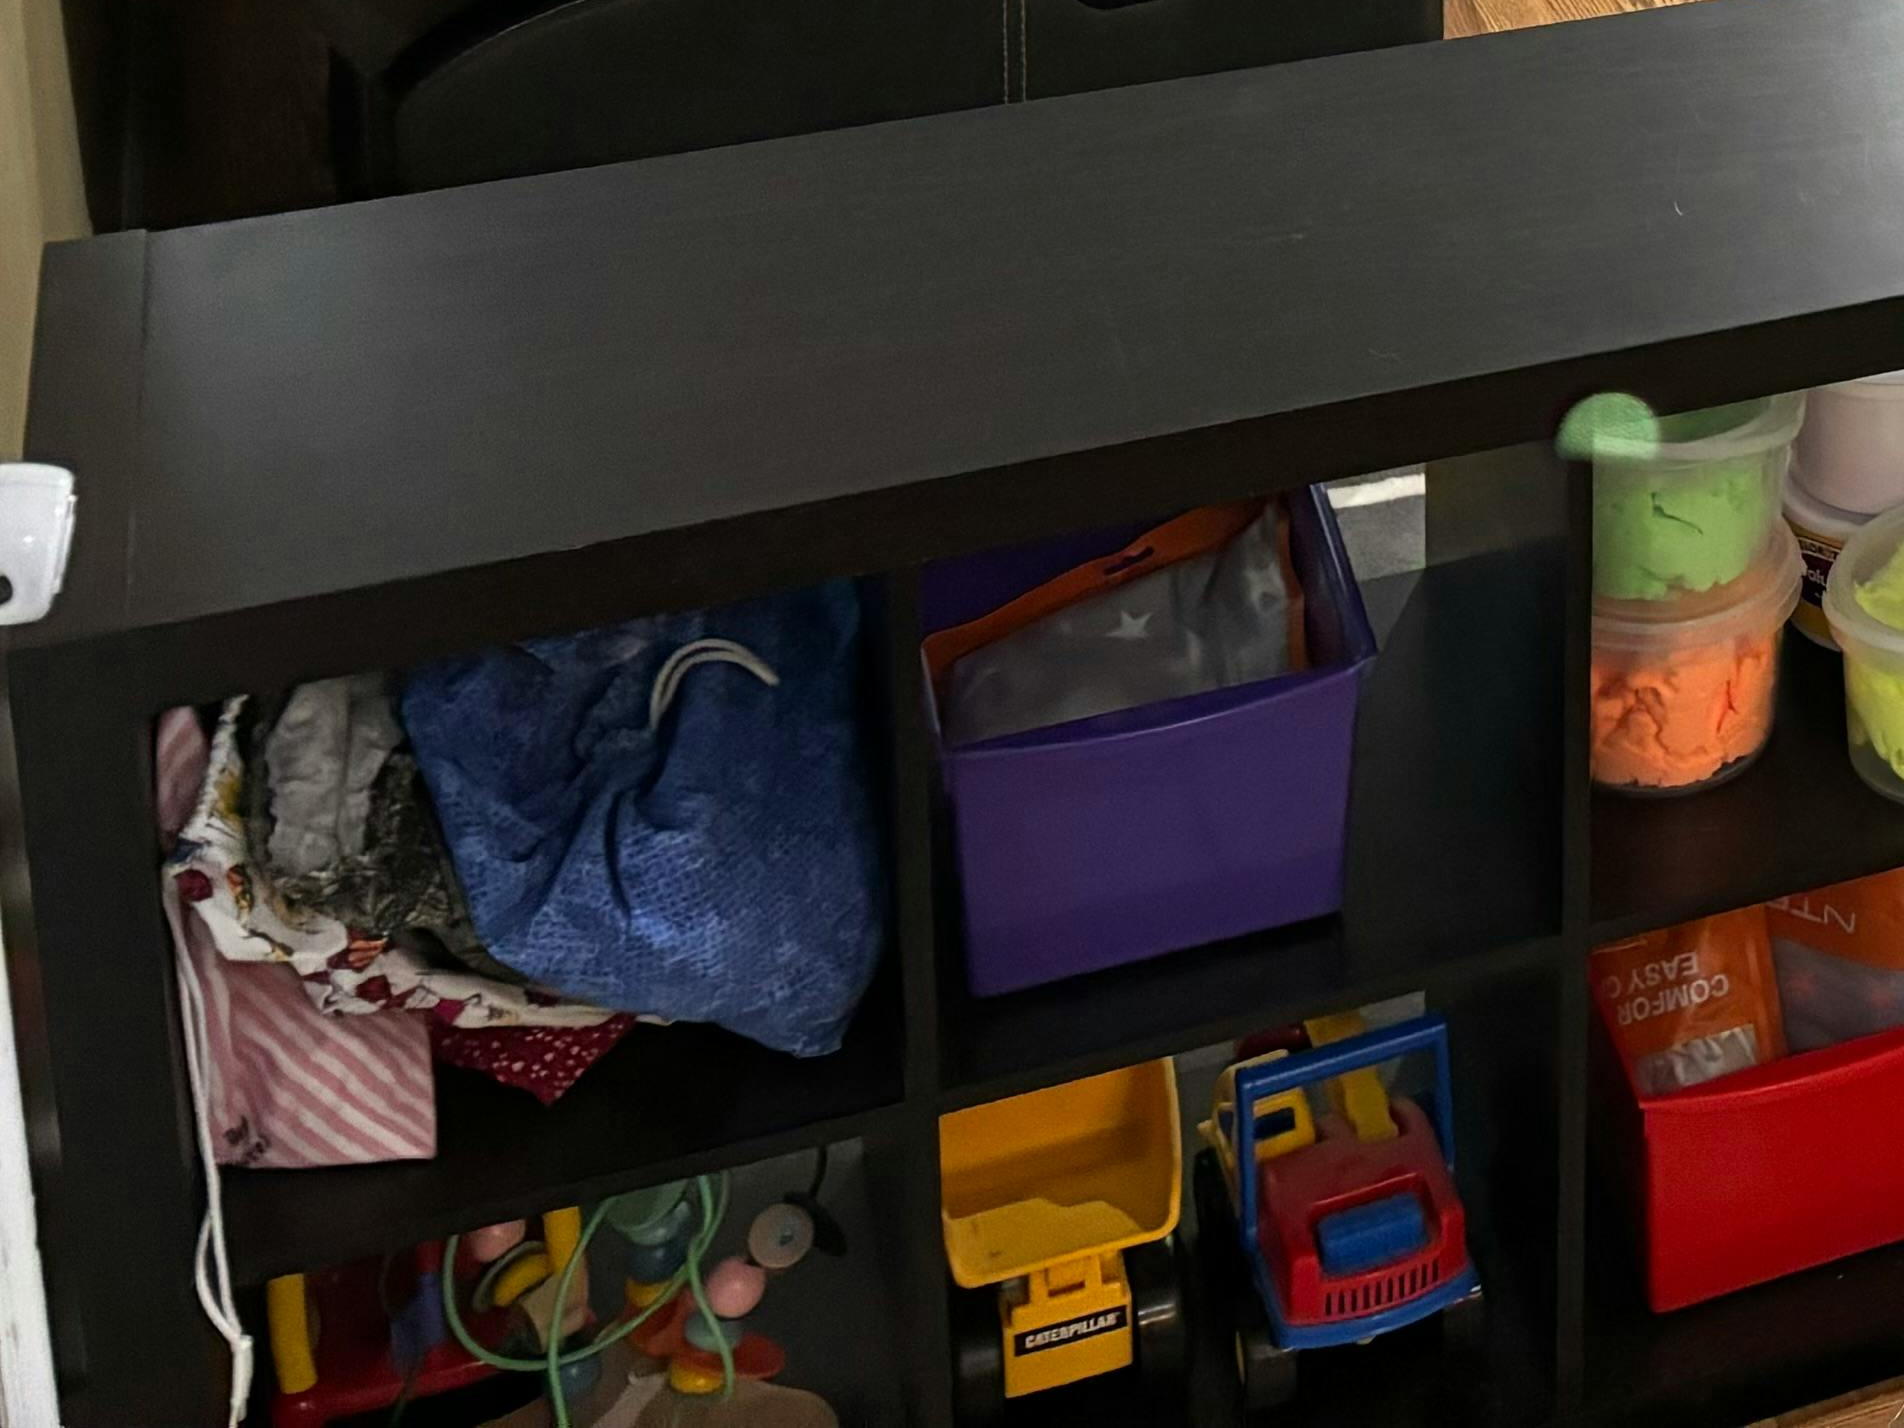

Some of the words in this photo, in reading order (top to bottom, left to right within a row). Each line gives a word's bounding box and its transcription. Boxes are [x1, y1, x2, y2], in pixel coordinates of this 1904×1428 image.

[1633, 951, 1698, 991] EASY
[1617, 973, 1728, 1026] COMFOR
[1025, 1310, 1117, 1349] CATERPILLAR
